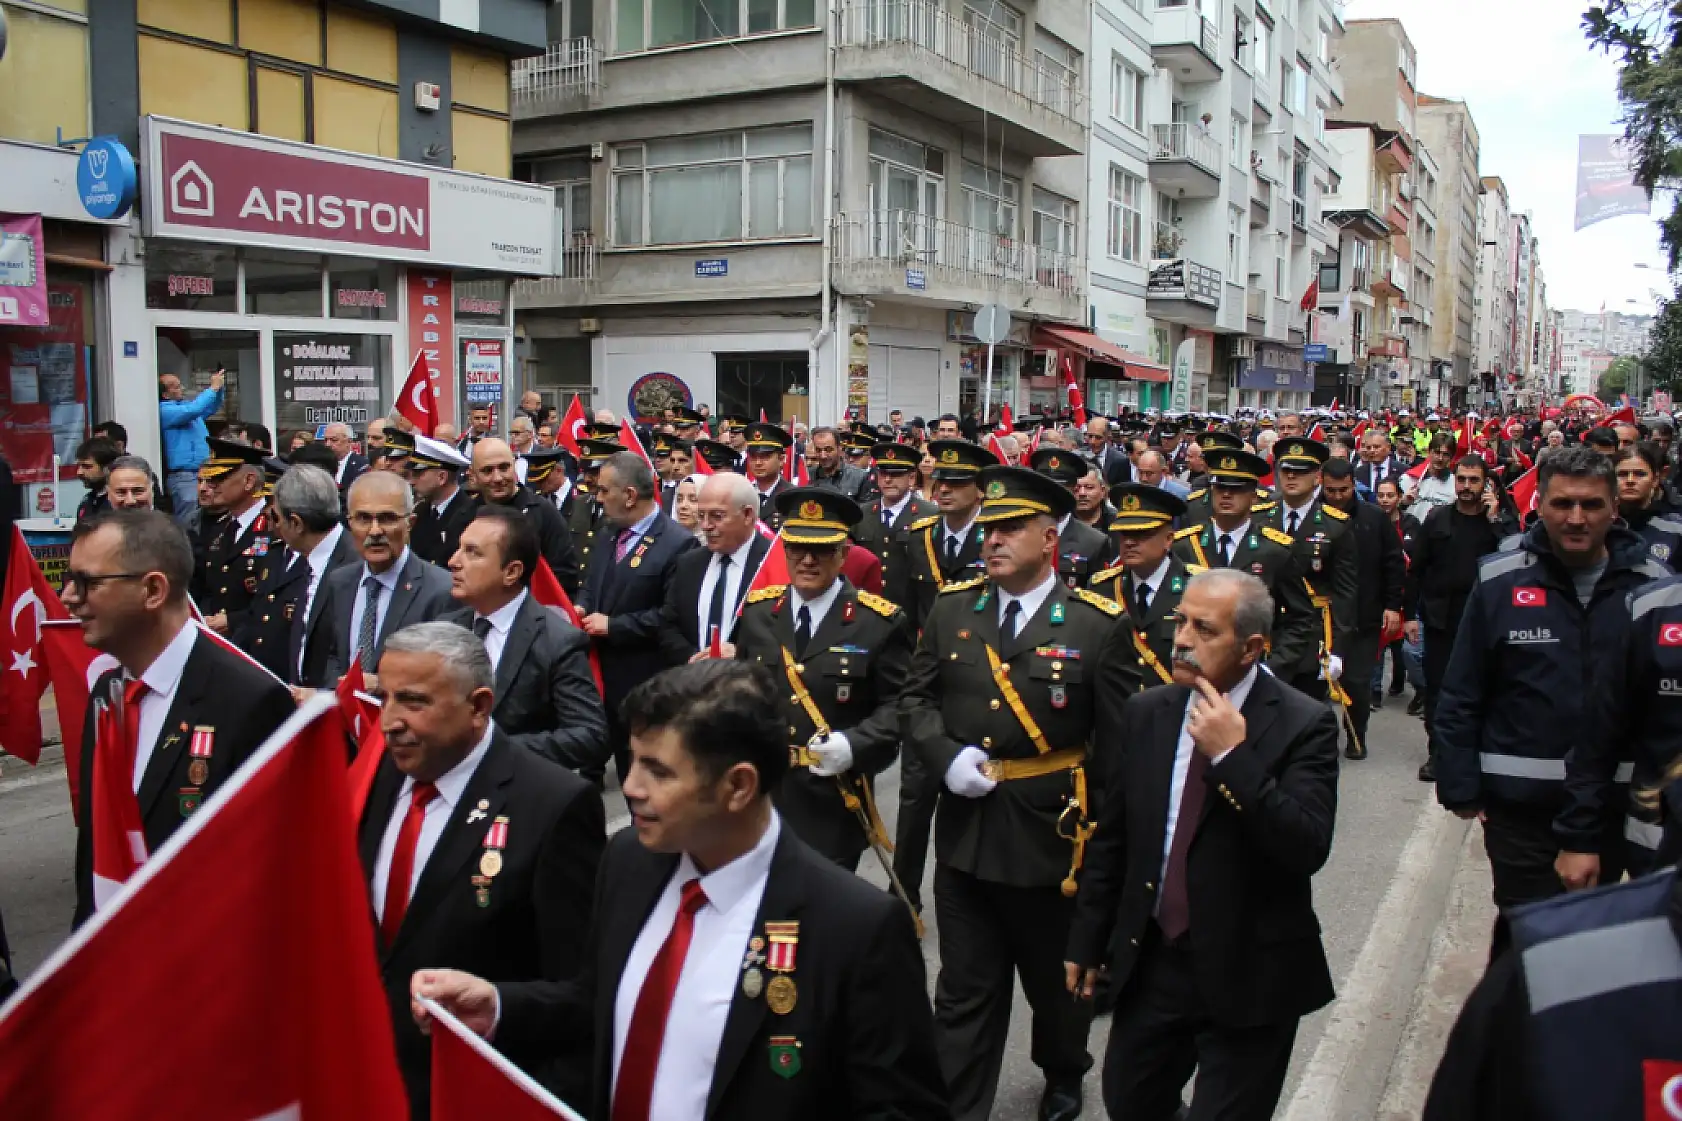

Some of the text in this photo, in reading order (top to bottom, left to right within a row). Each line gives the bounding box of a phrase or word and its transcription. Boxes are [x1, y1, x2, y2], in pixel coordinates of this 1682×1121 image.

[238, 186, 424, 236] ARISTON
[168, 274, 213, 296] ŞOFBEN
[292, 341, 350, 360] DOĞALGAZ
[467, 371, 499, 384] SATILIK
[1509, 626, 1551, 640] POLİS
